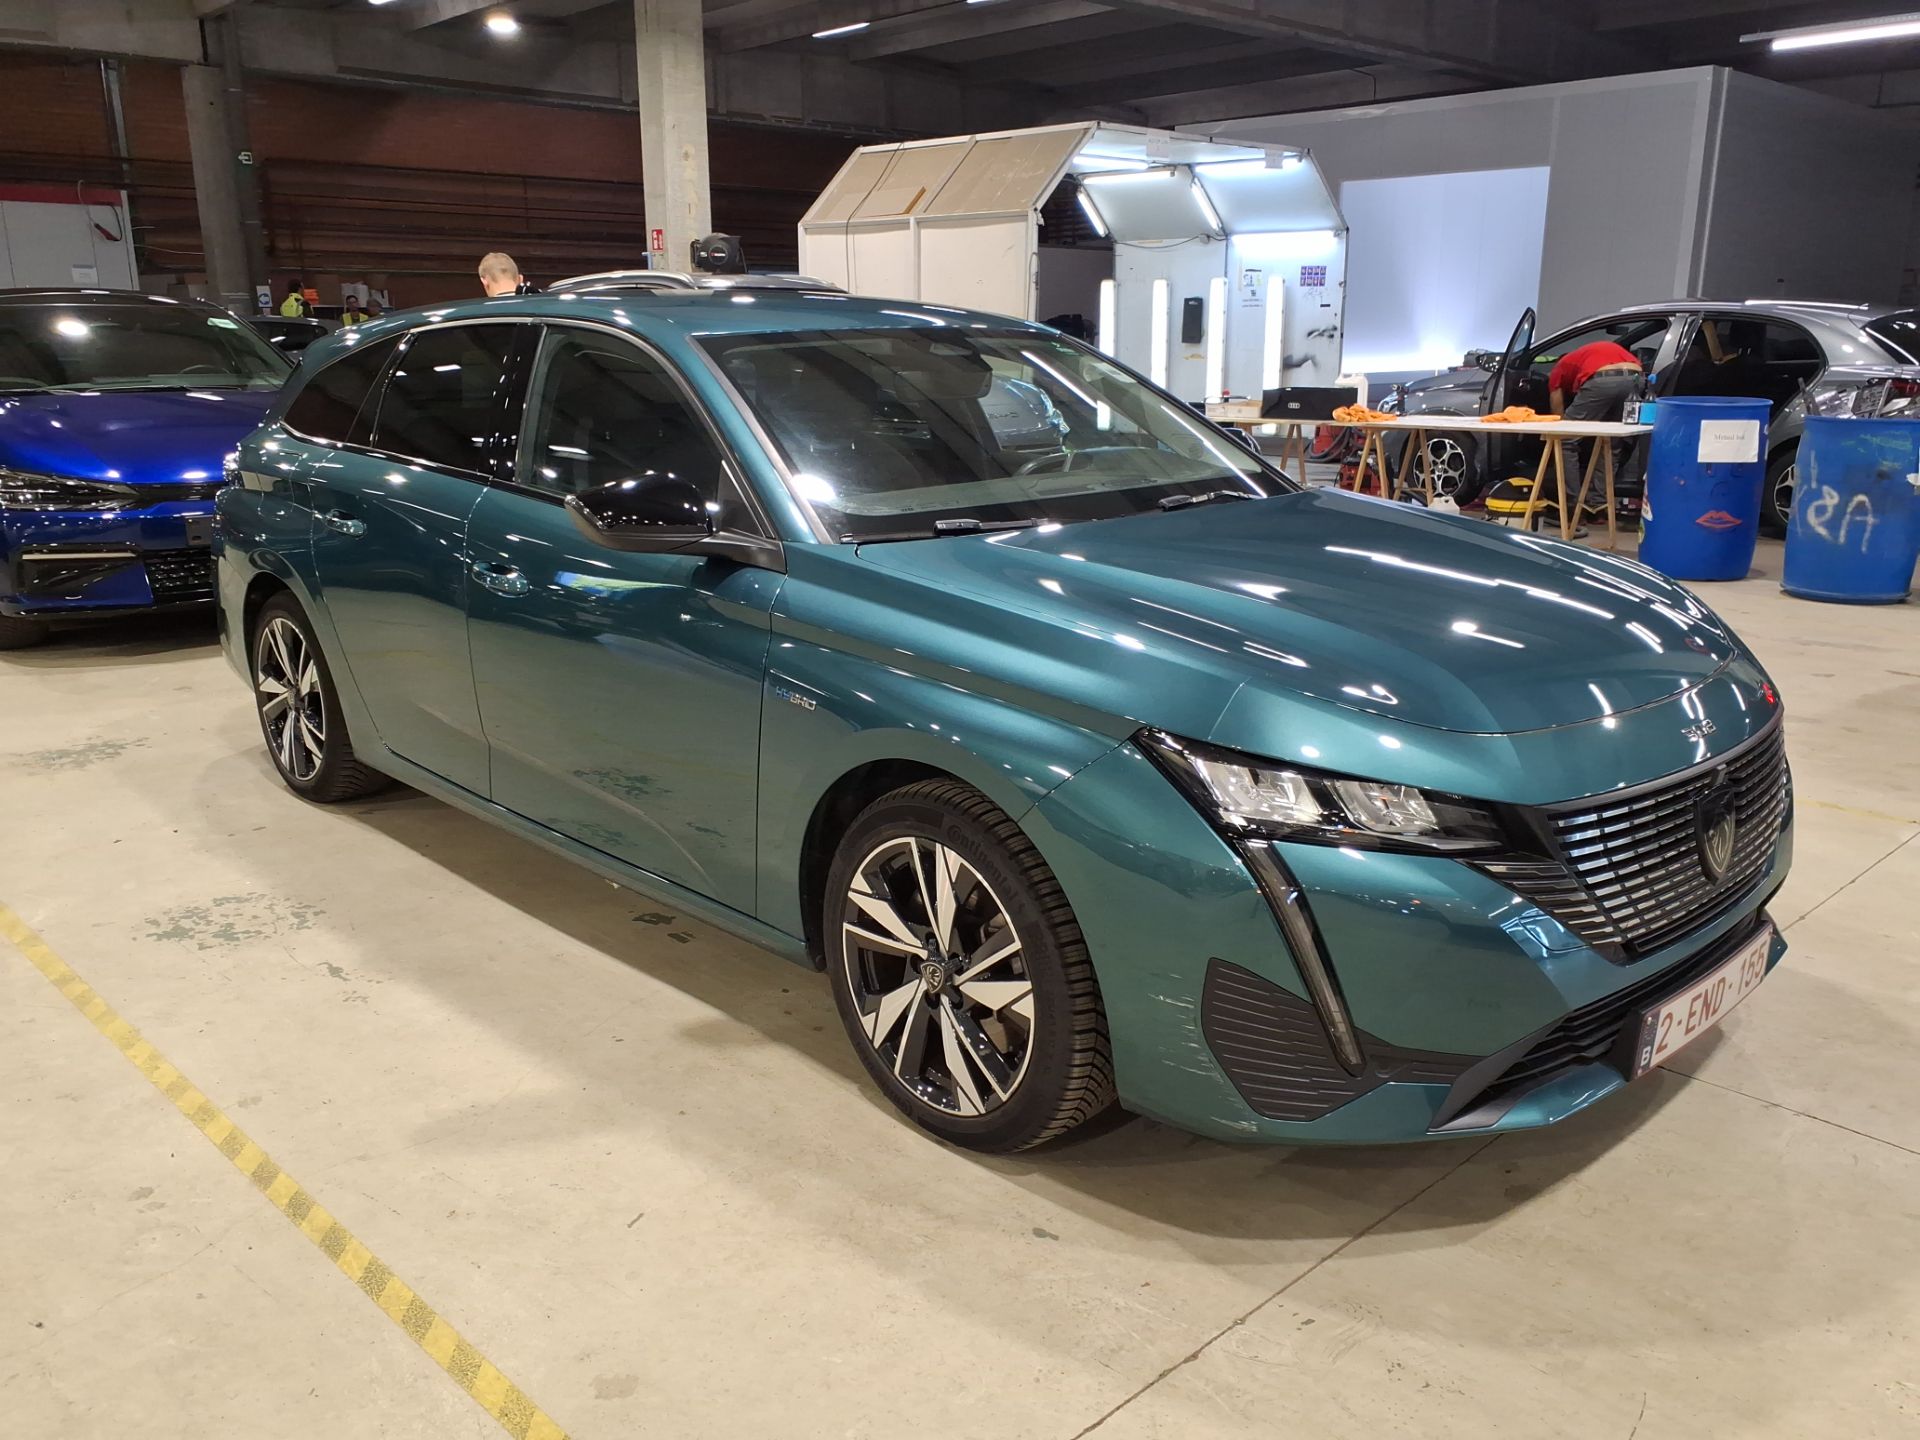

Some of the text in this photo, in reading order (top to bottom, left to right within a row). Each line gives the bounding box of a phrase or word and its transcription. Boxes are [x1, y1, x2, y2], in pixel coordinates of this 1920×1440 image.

[776, 686, 817, 711] HYBRID
[1680, 719, 1717, 742] 308
[946, 824, 1021, 901] Continental
[1641, 1045, 1652, 1067] B
